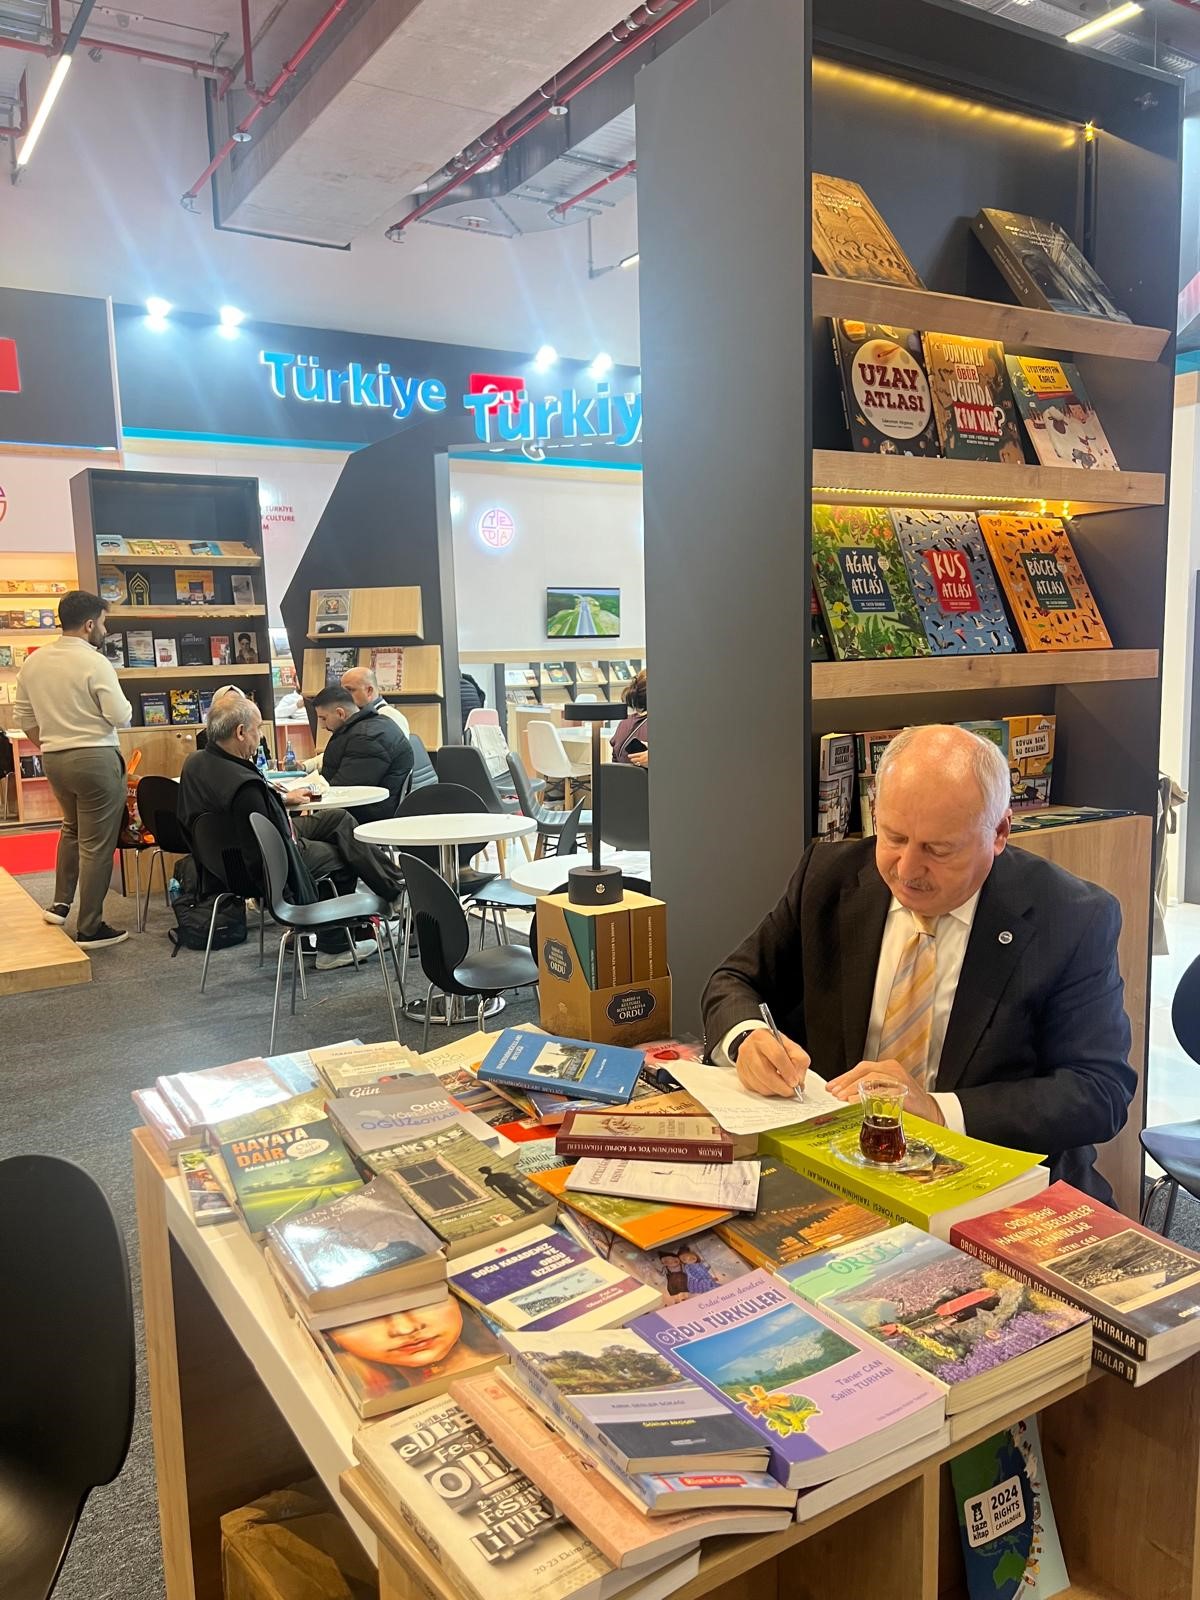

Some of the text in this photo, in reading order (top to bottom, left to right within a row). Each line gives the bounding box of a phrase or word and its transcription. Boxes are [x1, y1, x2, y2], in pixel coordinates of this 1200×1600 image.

[260, 350, 447, 419] Türkiye
[858, 363, 918, 390] UZAY
[864, 390, 925, 412] ATLASI
[949, 380, 994, 407] UCUNDA
[846, 551, 878, 579] AĞAÇ
[933, 552, 966, 582] KUŞ
[1026, 558, 1059, 576] BÖCEK
[852, 578, 884, 595] ATLASI
[942, 583, 972, 598] ATLASI
[1037, 581, 1065, 595] ATLASI
[550, 960, 566, 974] ORDU
[619, 1008, 644, 1019] ORDU
[349, 1086, 381, 1098] Gün
[410, 1099, 449, 1112] Ordu
[231, 1127, 309, 1154] HAYATA
[236, 1147, 286, 1168] DAİR
[994, 1204, 1095, 1247] HAKKINDA DERLEMELER
[1004, 1215, 1034, 1230] ORDU
[539, 1252, 566, 1266] ORDU
[543, 1247, 559, 1256] VE
[826, 1239, 904, 1274] ORDU
[471, 1264, 499, 1279] DOĞU
[960, 1239, 978, 1256] ORDU
[1000, 1261, 1032, 1288] HAKKINDA
[1092, 1315, 1136, 1350] HATIRALAR
[656, 1286, 787, 1345] ORDU TÜRKÜLERİ
[835, 1359, 883, 1386] Taner CAN
[831, 1366, 894, 1401] Salih TURHAN
[431, 1450, 513, 1499] OR
[990, 1485, 1019, 1510] 2024
[993, 1500, 1020, 1521] RIGHTS
[972, 1520, 988, 1532] taze
[995, 1512, 1022, 1531] CATALOGUE
[973, 1530, 990, 1541] kitap
